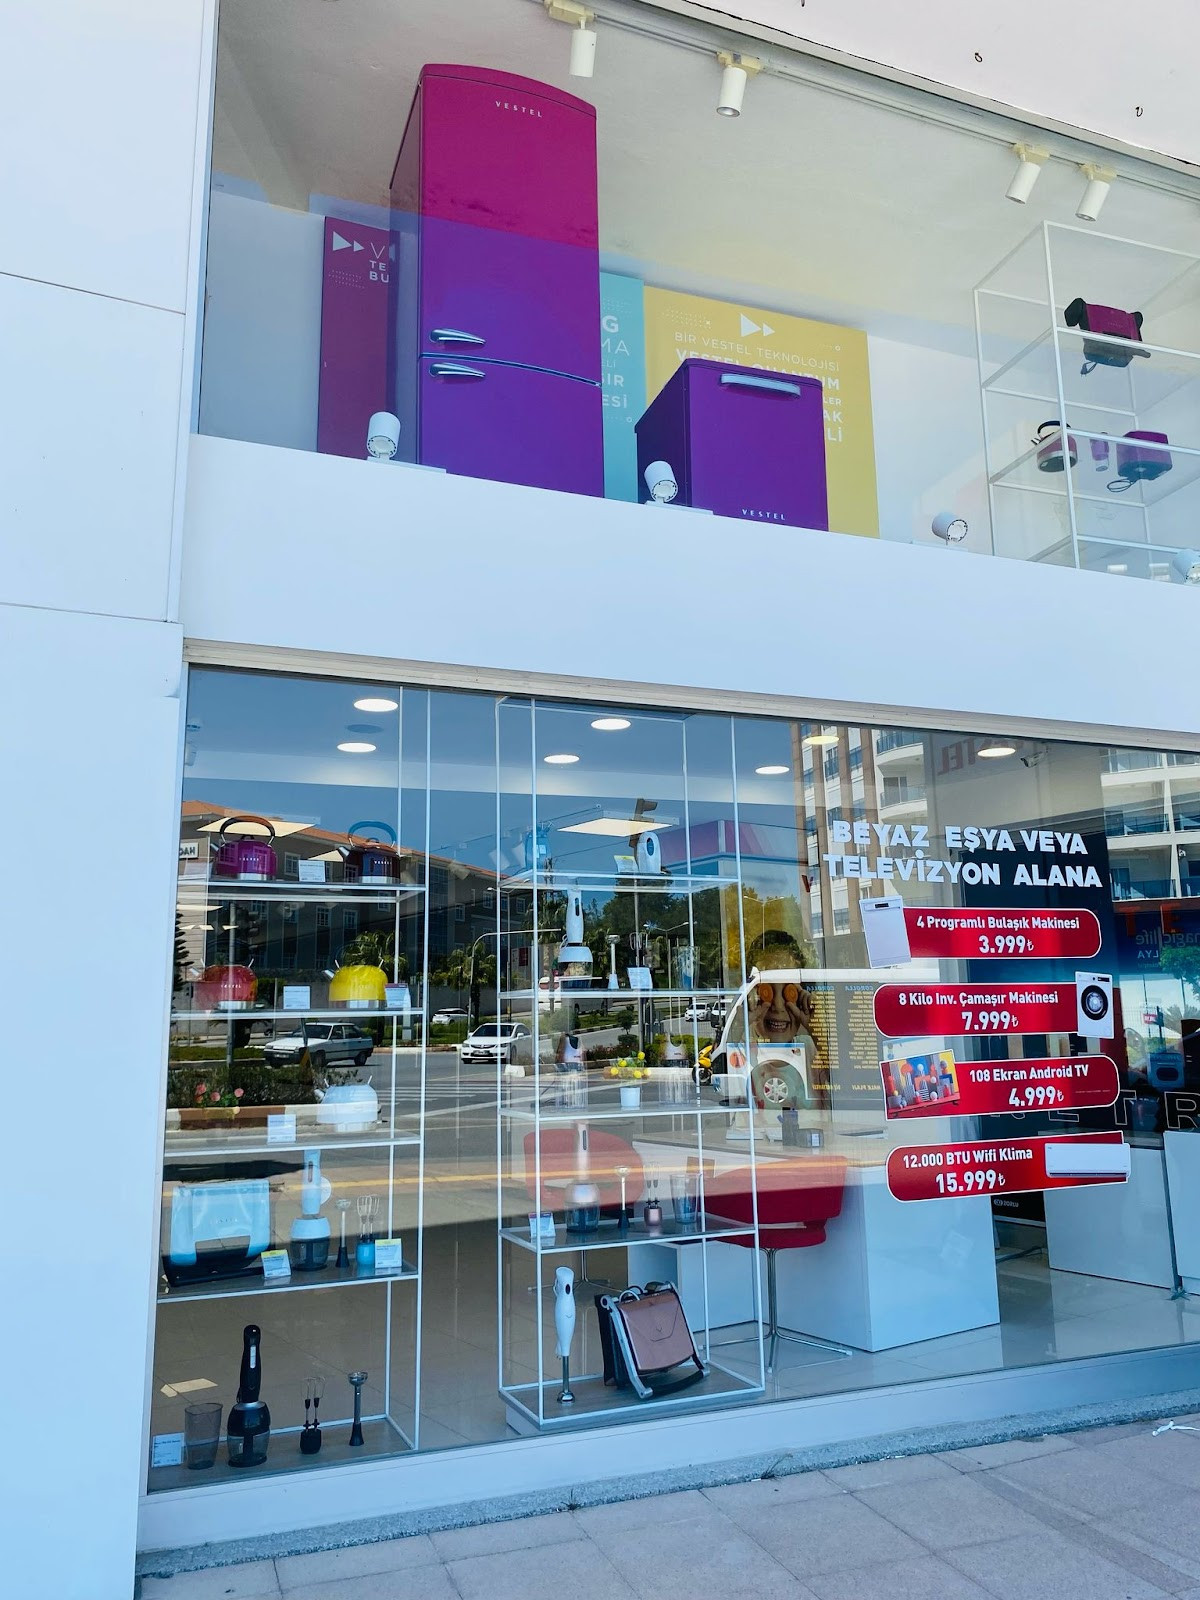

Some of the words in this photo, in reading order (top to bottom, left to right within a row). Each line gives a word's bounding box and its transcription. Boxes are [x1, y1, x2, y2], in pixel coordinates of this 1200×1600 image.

[495, 100, 542, 118] VESTEL
[674, 331, 697, 343] BİR
[702, 337, 751, 355] VESTEL
[742, 508, 786, 521] VESTEL
[832, 820, 929, 848] BEYAZ
[945, 825, 1016, 853] EŞYA
[1020, 829, 1088, 855] VEYA
[822, 849, 1001, 885] TELEVİZYON
[1013, 863, 1103, 888] ALANA
[916, 915, 925, 929] 4
[927, 915, 985, 931] Programlı
[988, 916, 1029, 931] Bulaşık
[1032, 916, 1080, 929] Makinesi
[899, 992, 906, 1005] 8
[909, 992, 933, 1005] Kilo
[936, 992, 957, 1005] Inv.
[959, 992, 1007, 1008] Çamaşır
[1009, 991, 1059, 1004] Makinesi
[969, 1069, 991, 1082] 108
[993, 1068, 1028, 1081] Ekran
[1029, 1065, 1073, 1080] Android
[1075, 1064, 1089, 1077] TV
[903, 1152, 944, 1169] 12.000
[946, 1150, 971, 1166] BTU
[972, 1148, 997, 1163] Wifi
[999, 1147, 1033, 1161] Klima
